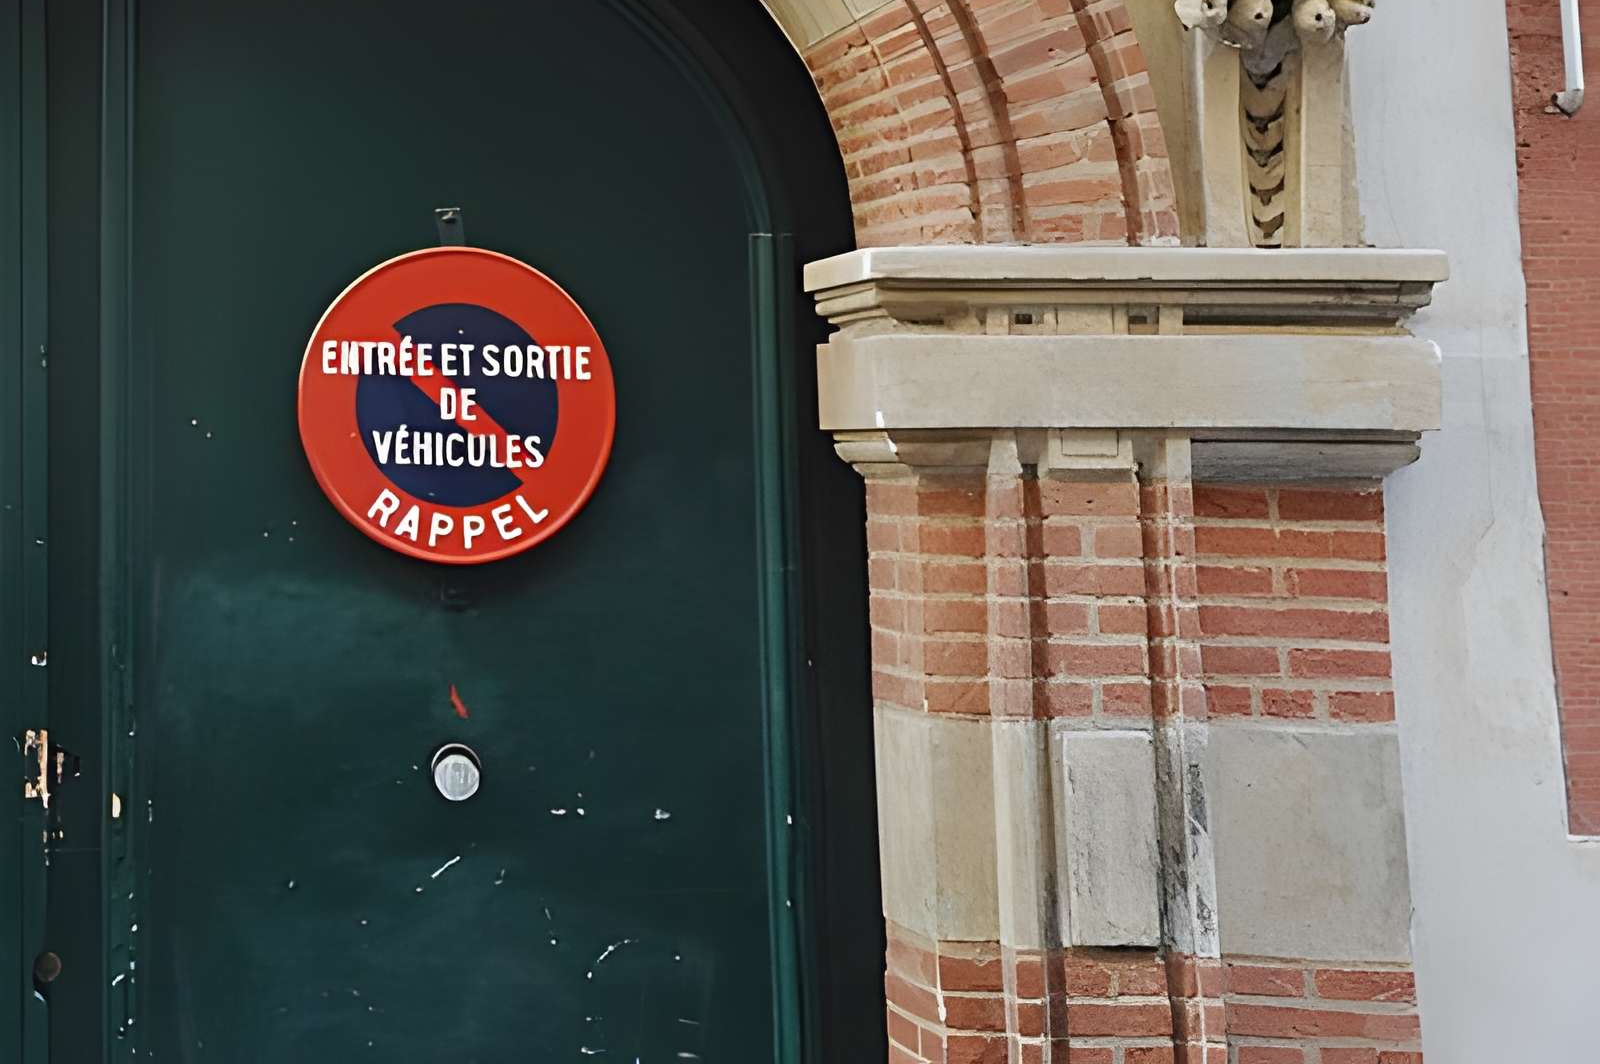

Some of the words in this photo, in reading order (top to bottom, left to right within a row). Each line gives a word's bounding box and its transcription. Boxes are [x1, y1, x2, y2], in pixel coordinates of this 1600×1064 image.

[322, 335, 434, 377] ENTRÉE
[440, 343, 476, 377] ET
[481, 344, 593, 380] SORTIE
[439, 387, 478, 421] DE
[372, 423, 545, 469] VÉHICULES
[367, 488, 549, 549] RAPPEL
